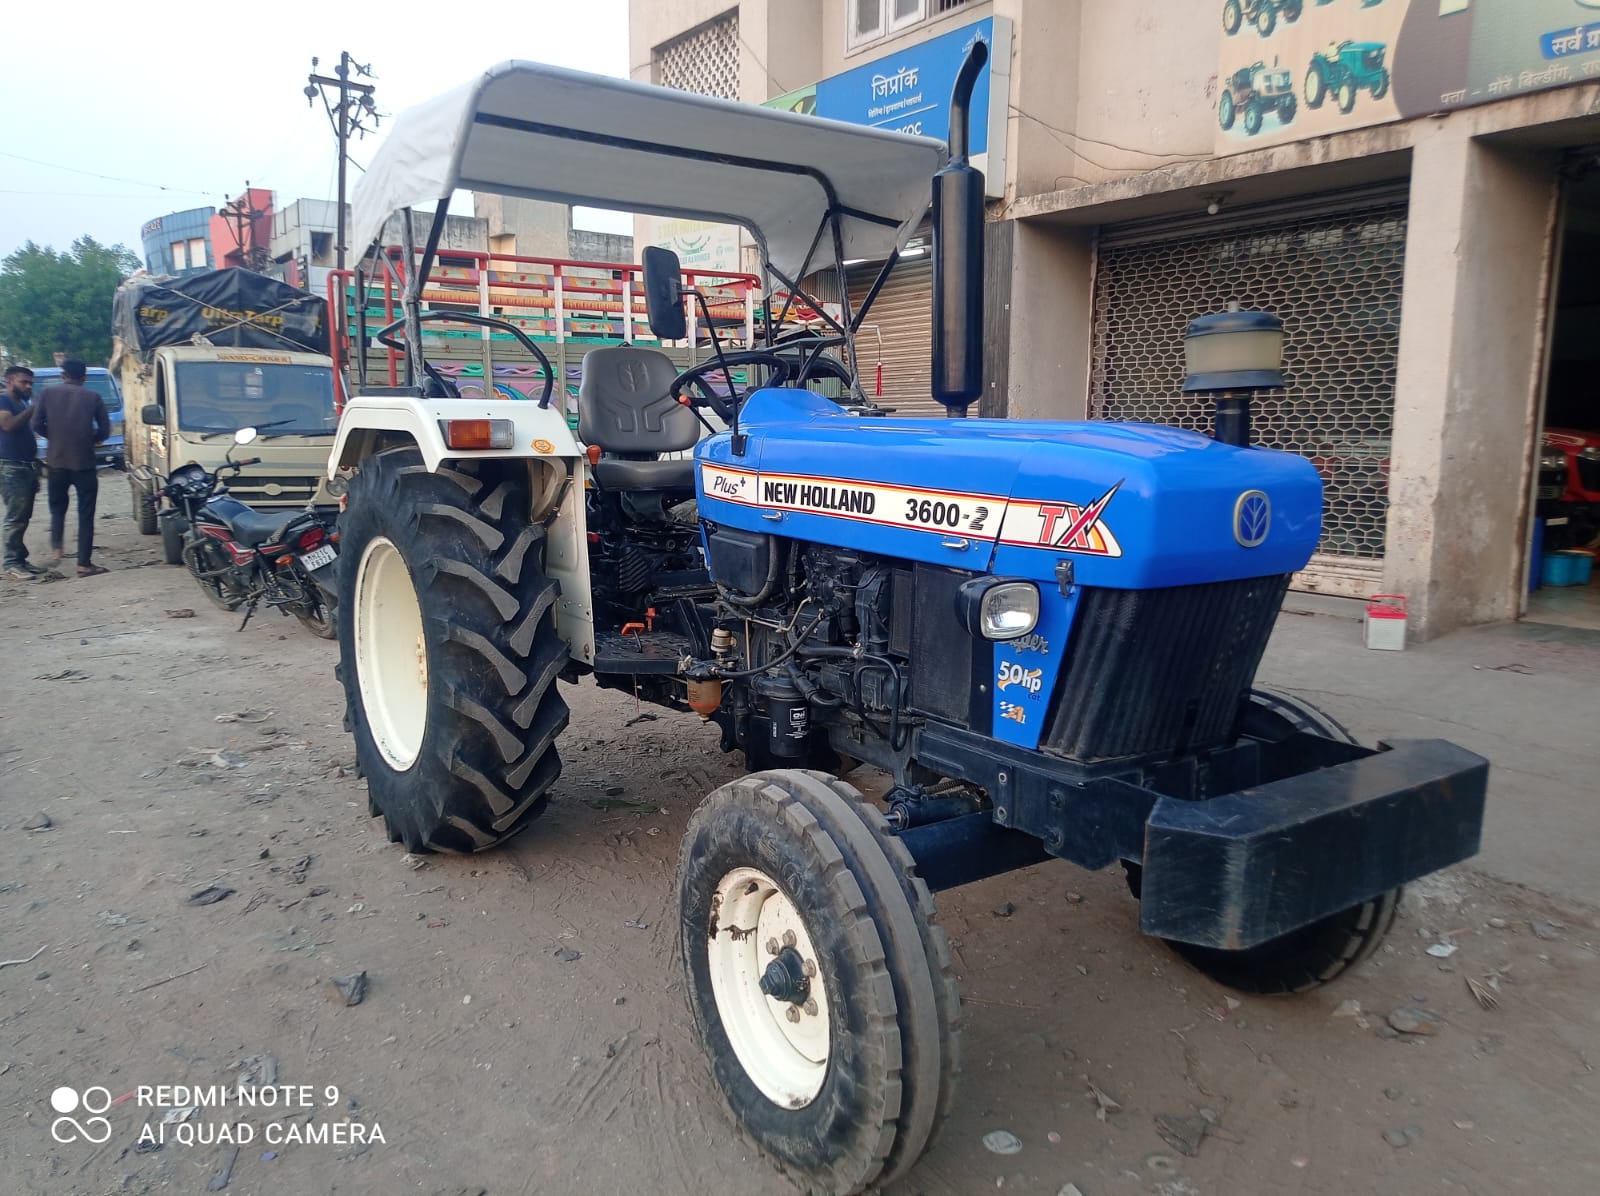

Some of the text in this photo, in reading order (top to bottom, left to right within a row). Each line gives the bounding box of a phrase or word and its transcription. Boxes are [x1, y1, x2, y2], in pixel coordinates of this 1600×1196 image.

[1551, 27, 1582, 55] सर्व
[872, 66, 919, 101] जिप्रॉक
[764, 481, 875, 515] NEW HOLLAND
